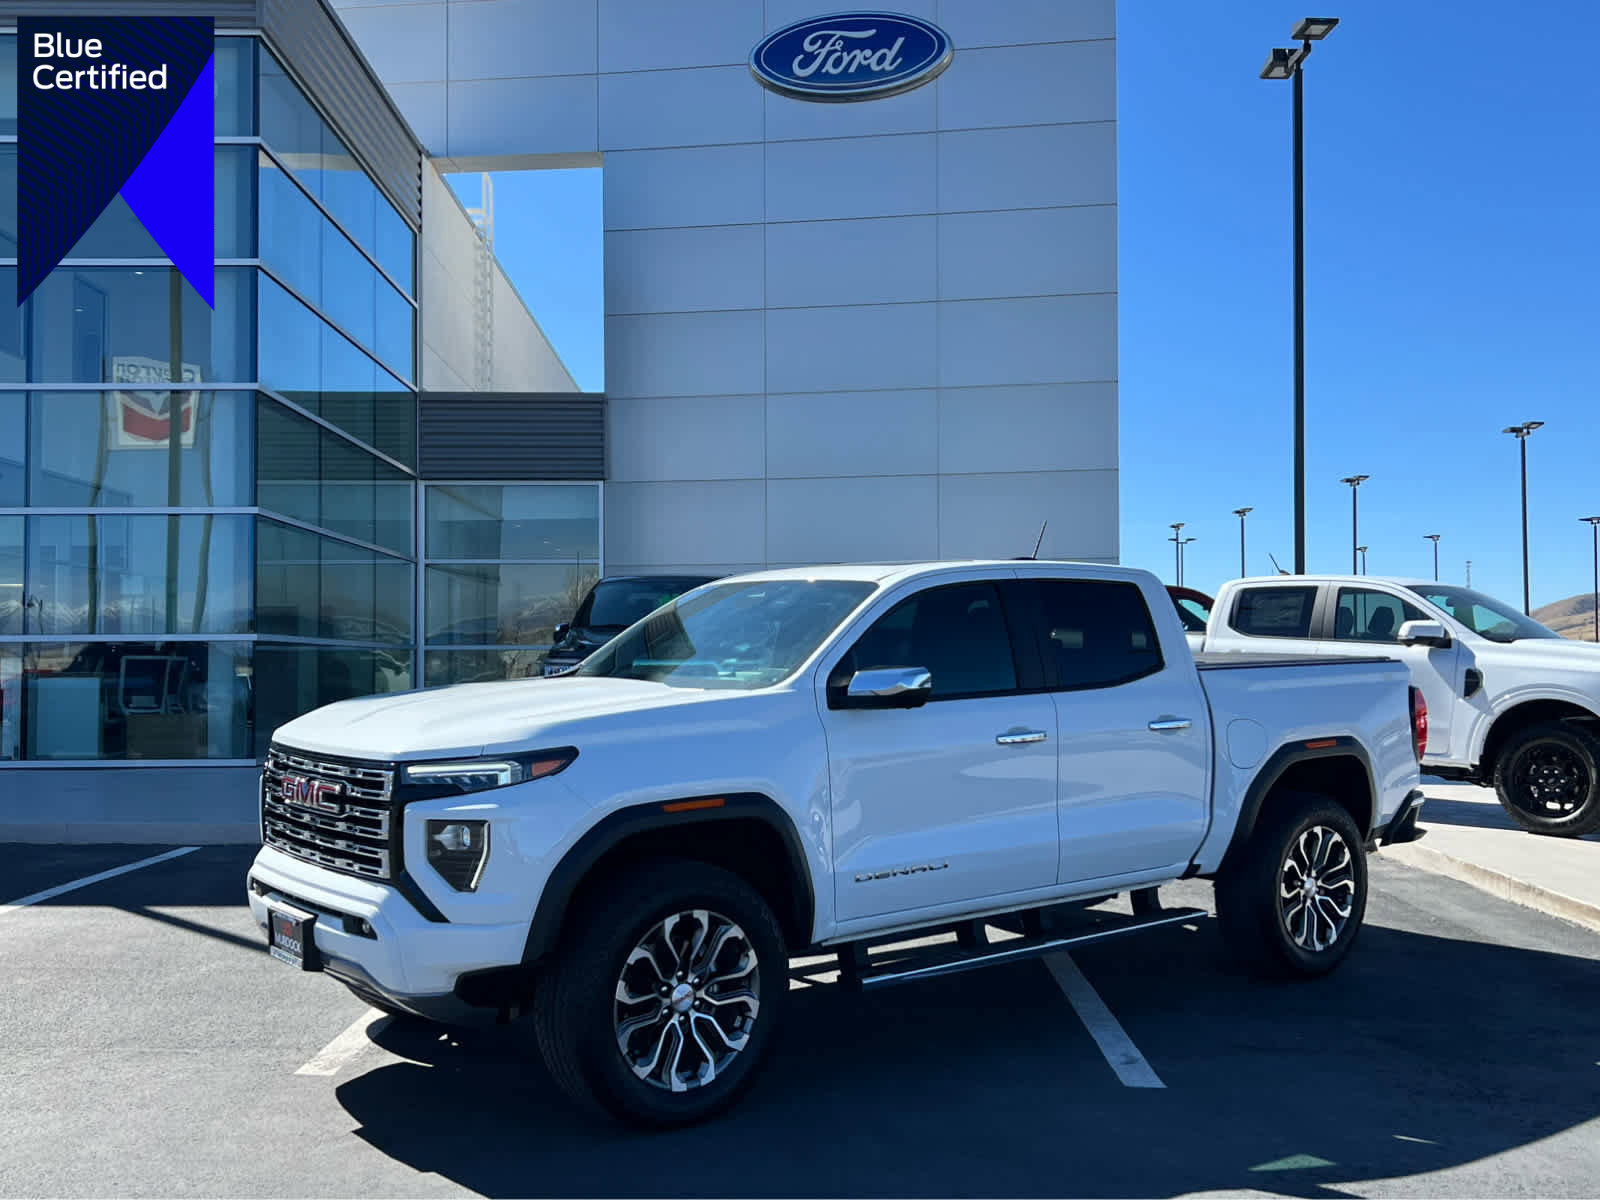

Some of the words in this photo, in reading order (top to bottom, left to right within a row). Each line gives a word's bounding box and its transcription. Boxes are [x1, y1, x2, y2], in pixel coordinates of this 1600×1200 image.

[792, 29, 905, 78] Ford
[281, 776, 341, 814] GMC
[855, 862, 948, 883] DENALI
